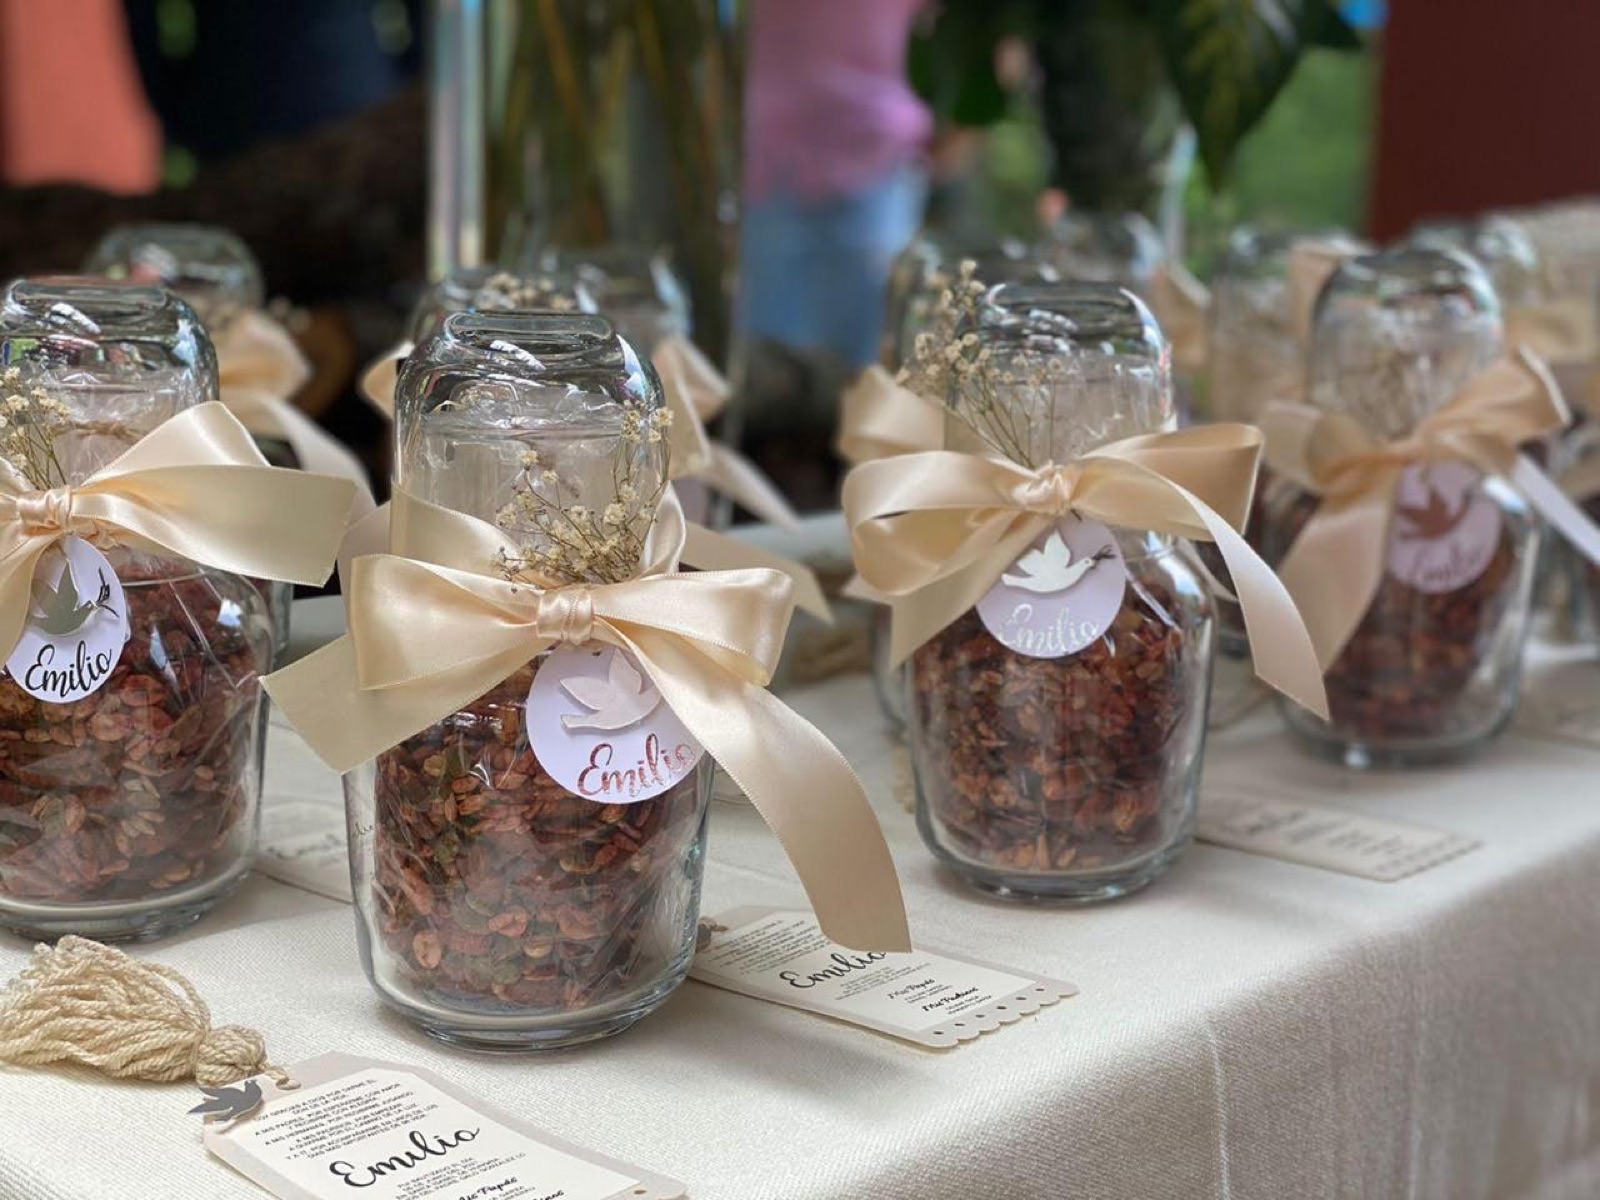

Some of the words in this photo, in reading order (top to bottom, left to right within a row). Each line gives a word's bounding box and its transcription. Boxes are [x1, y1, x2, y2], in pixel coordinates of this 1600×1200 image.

[1000, 604, 1099, 655] Emilio
[25, 640, 112, 698] Emilio
[578, 733, 697, 797] Emilio
[780, 951, 887, 989] Emilio
[329, 1127, 480, 1187] Emilio
